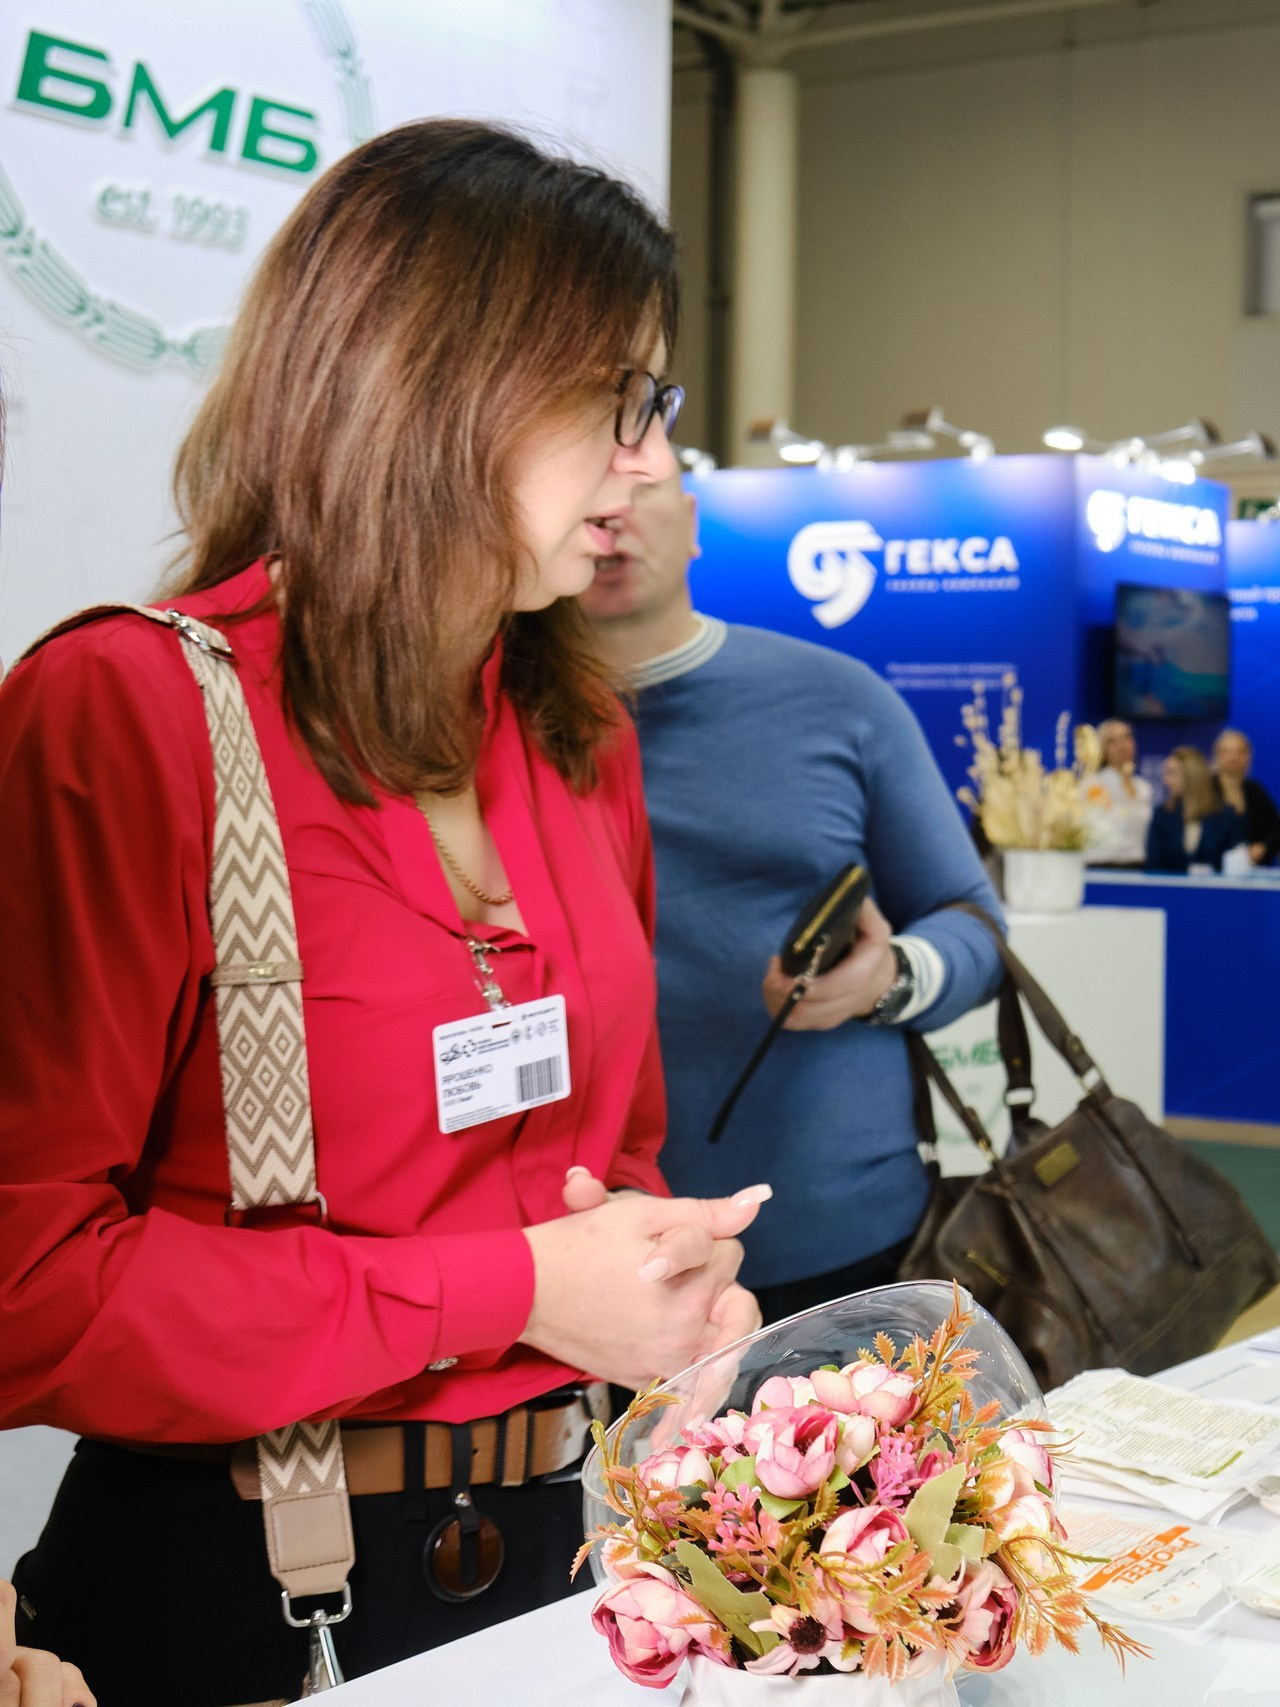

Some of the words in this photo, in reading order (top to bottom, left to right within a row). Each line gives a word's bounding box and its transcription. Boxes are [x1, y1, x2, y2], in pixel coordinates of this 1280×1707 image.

[16, 28, 318, 173] БМБ
[170, 193, 250, 249] 1993
[884, 536, 1020, 576] ГЕКСА
